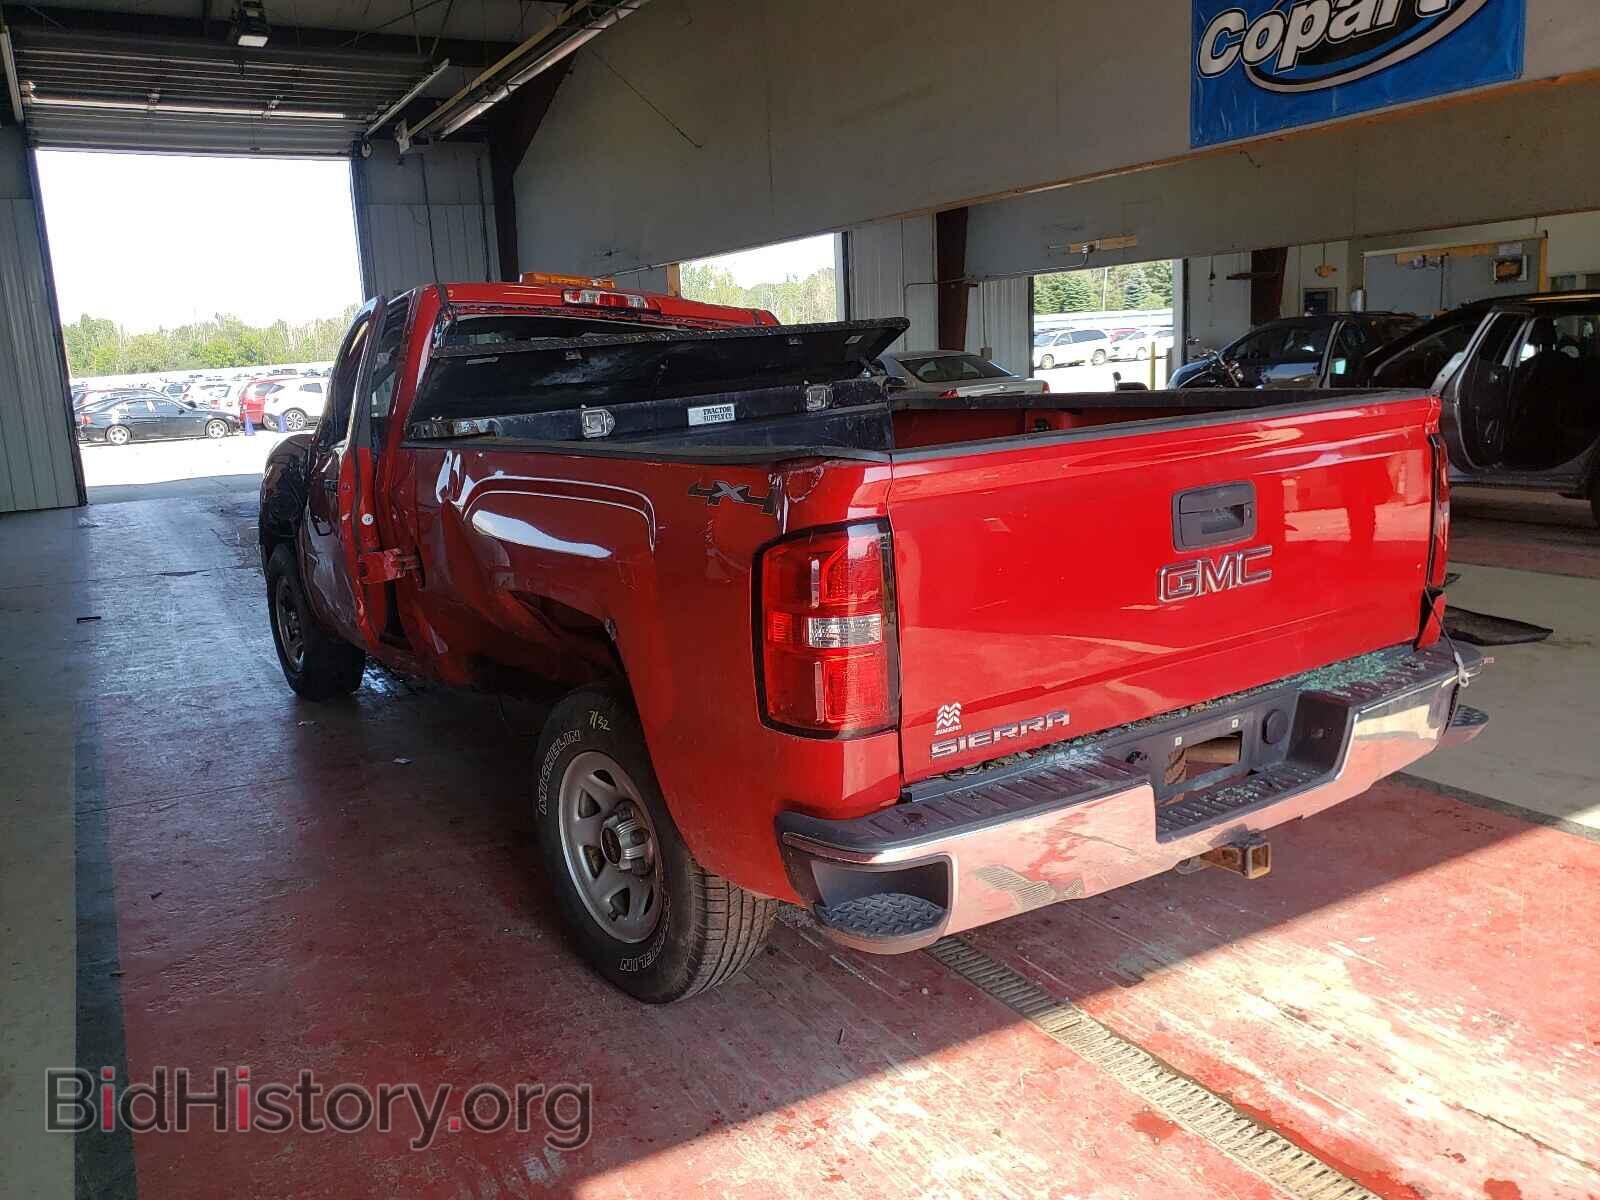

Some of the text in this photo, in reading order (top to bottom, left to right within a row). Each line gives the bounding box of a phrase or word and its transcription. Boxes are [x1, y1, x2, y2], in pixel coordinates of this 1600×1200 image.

[1198, 0, 1451, 78] Copar
[703, 406, 732, 416] TRACTOR
[703, 413, 725, 423] SUPPLY
[1157, 545, 1273, 603] GMC
[929, 709, 1071, 758] SIERRA
[537, 729, 581, 816] MICHELIN
